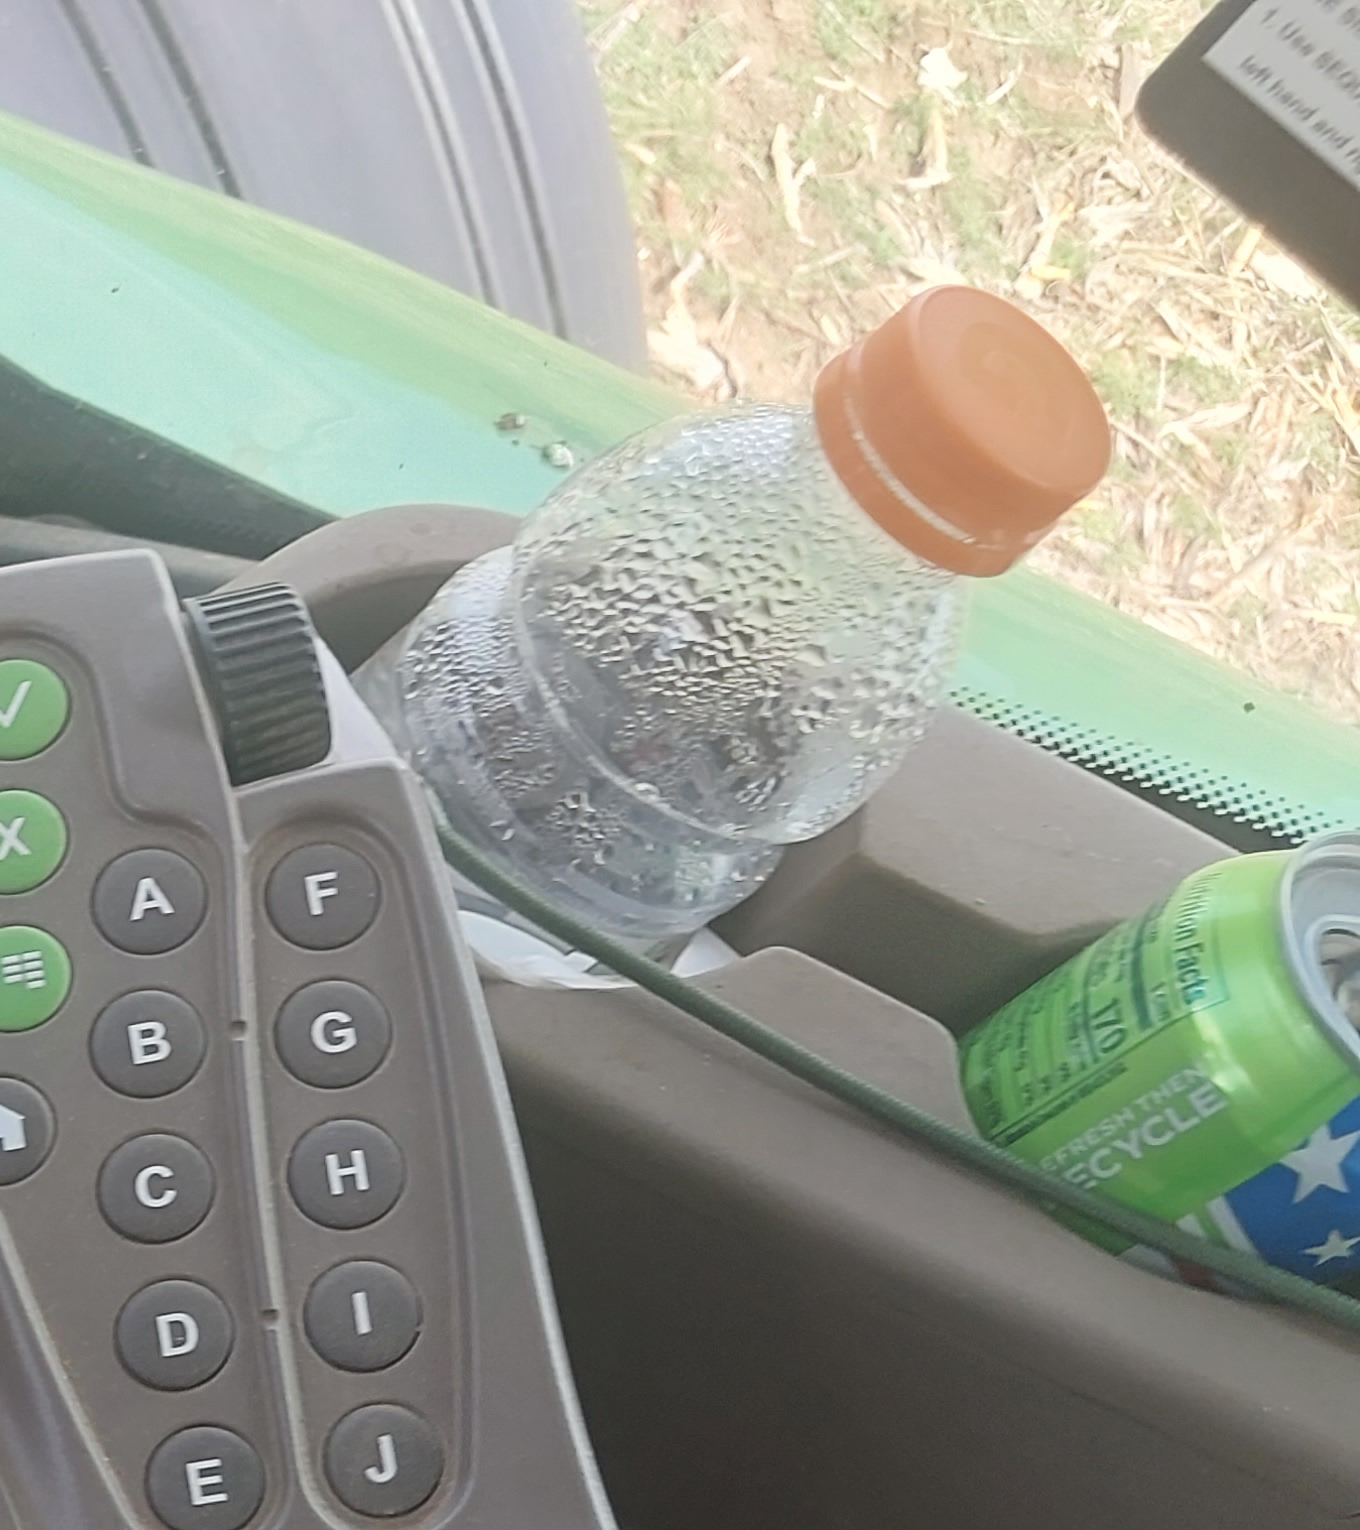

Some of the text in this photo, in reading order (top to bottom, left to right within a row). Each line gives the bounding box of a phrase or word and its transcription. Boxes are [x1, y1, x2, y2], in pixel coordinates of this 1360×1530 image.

[1277, 20, 1316, 57] Use
[1268, 78, 1320, 121] hand
[129, 877, 175, 921] A
[303, 871, 340, 916] F
[1174, 941, 1210, 1005] Facts
[127, 1021, 172, 1066] B
[310, 1011, 357, 1054] G
[1092, 998, 1128, 1054] 170
[1040, 1107, 1134, 1171] EFRESH
[1134, 1068, 1208, 1111] THEN
[1064, 1080, 1229, 1189] ECYCLE
[134, 1165, 177, 1208] C
[324, 1150, 371, 1195] H
[155, 1312, 199, 1358] D
[351, 1291, 373, 1335] I
[364, 1434, 398, 1483] J
[185, 1458, 229, 1506] E
